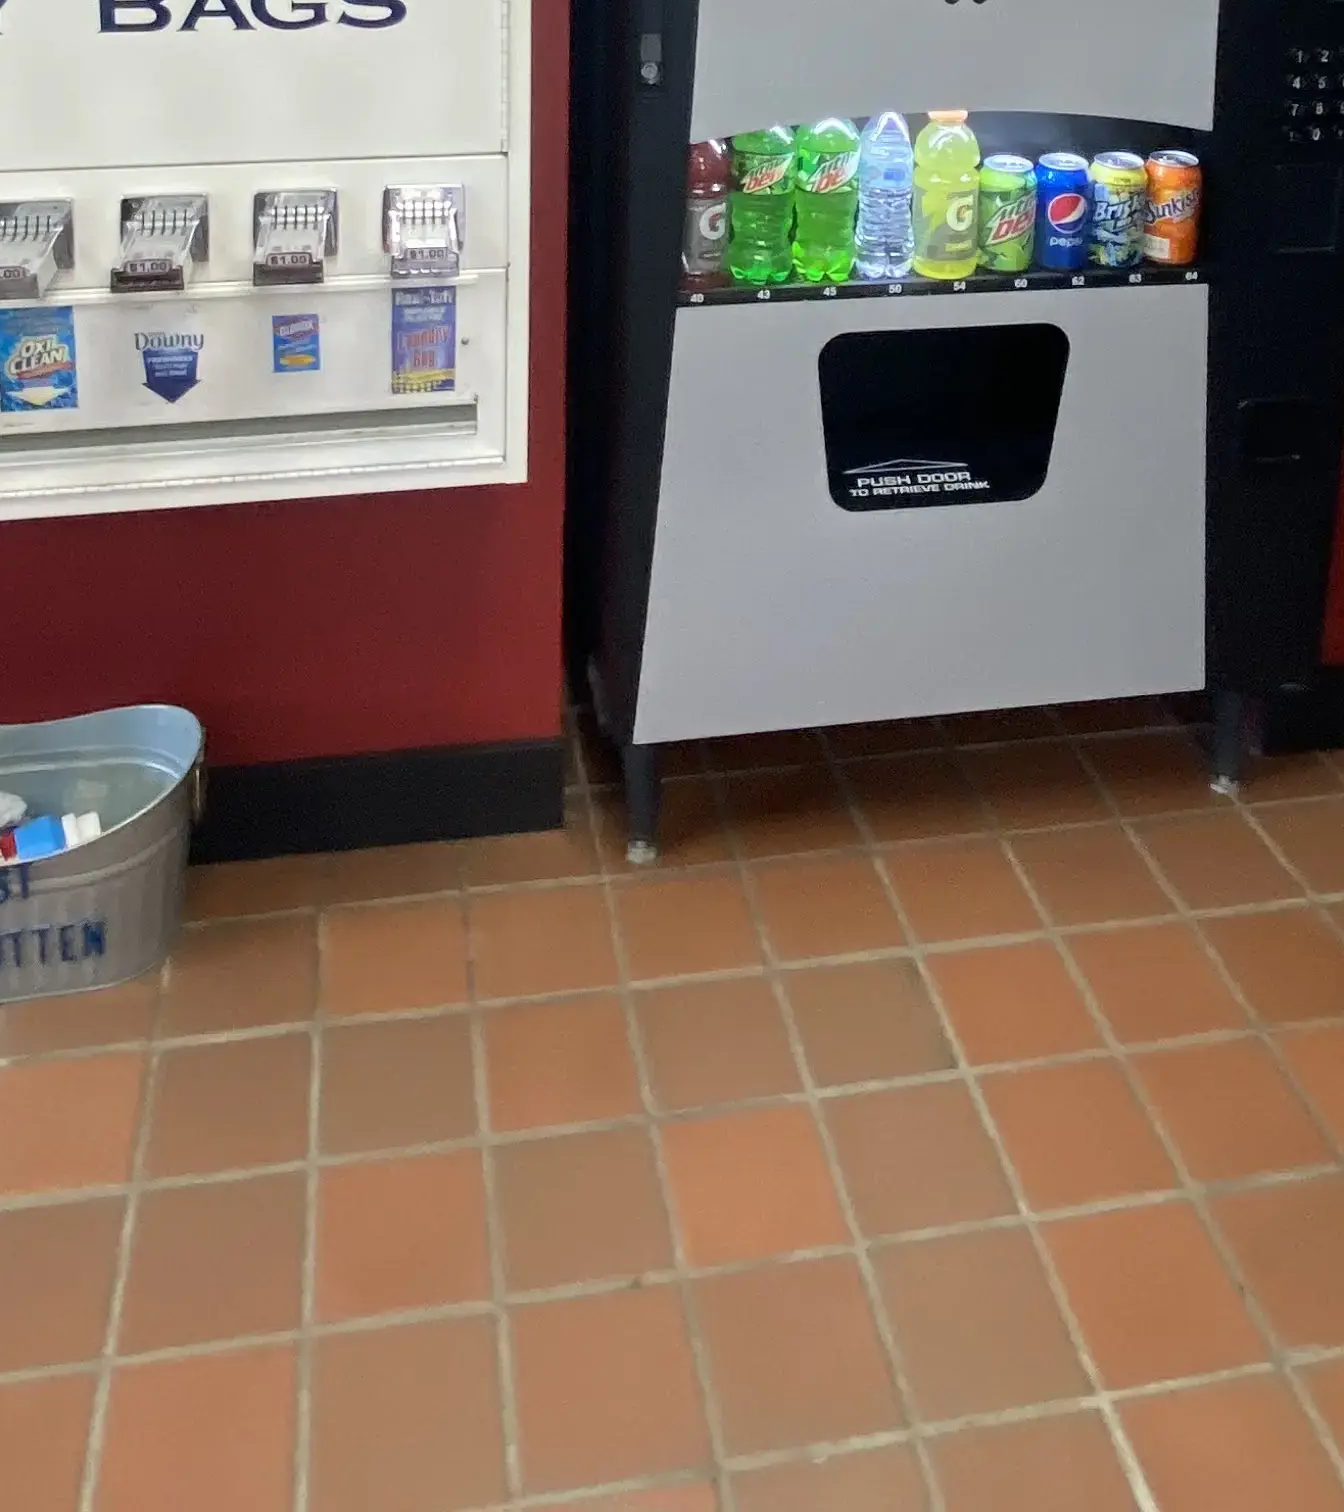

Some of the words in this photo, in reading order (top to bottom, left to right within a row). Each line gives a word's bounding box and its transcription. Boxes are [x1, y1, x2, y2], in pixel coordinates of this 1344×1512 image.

[1320, 50, 1329, 62] 2
[1292, 76, 1301, 89] 4
[1318, 76, 1328, 89] 5
[1292, 103, 1299, 116] 7
[1316, 102, 1323, 115] 8
[1312, 127, 1320, 141] 0
[946, 195, 974, 231] G
[699, 202, 727, 240] G
[270, 255, 307, 265] $1.00
[409, 249, 445, 259] $1.00
[129, 262, 167, 272] $1.00
[953, 281, 966, 291] 54
[757, 290, 771, 299] 43
[21, 340, 54, 357] OXI
[134, 332, 205, 351] Downy
[9, 350, 65, 373] CLEAN
[857, 475, 911, 488] PUSH
[917, 471, 972, 484] DOOR
[849, 488, 869, 497] TO
[872, 483, 941, 496] RETRIEVE
[944, 480, 990, 491] DRINK
